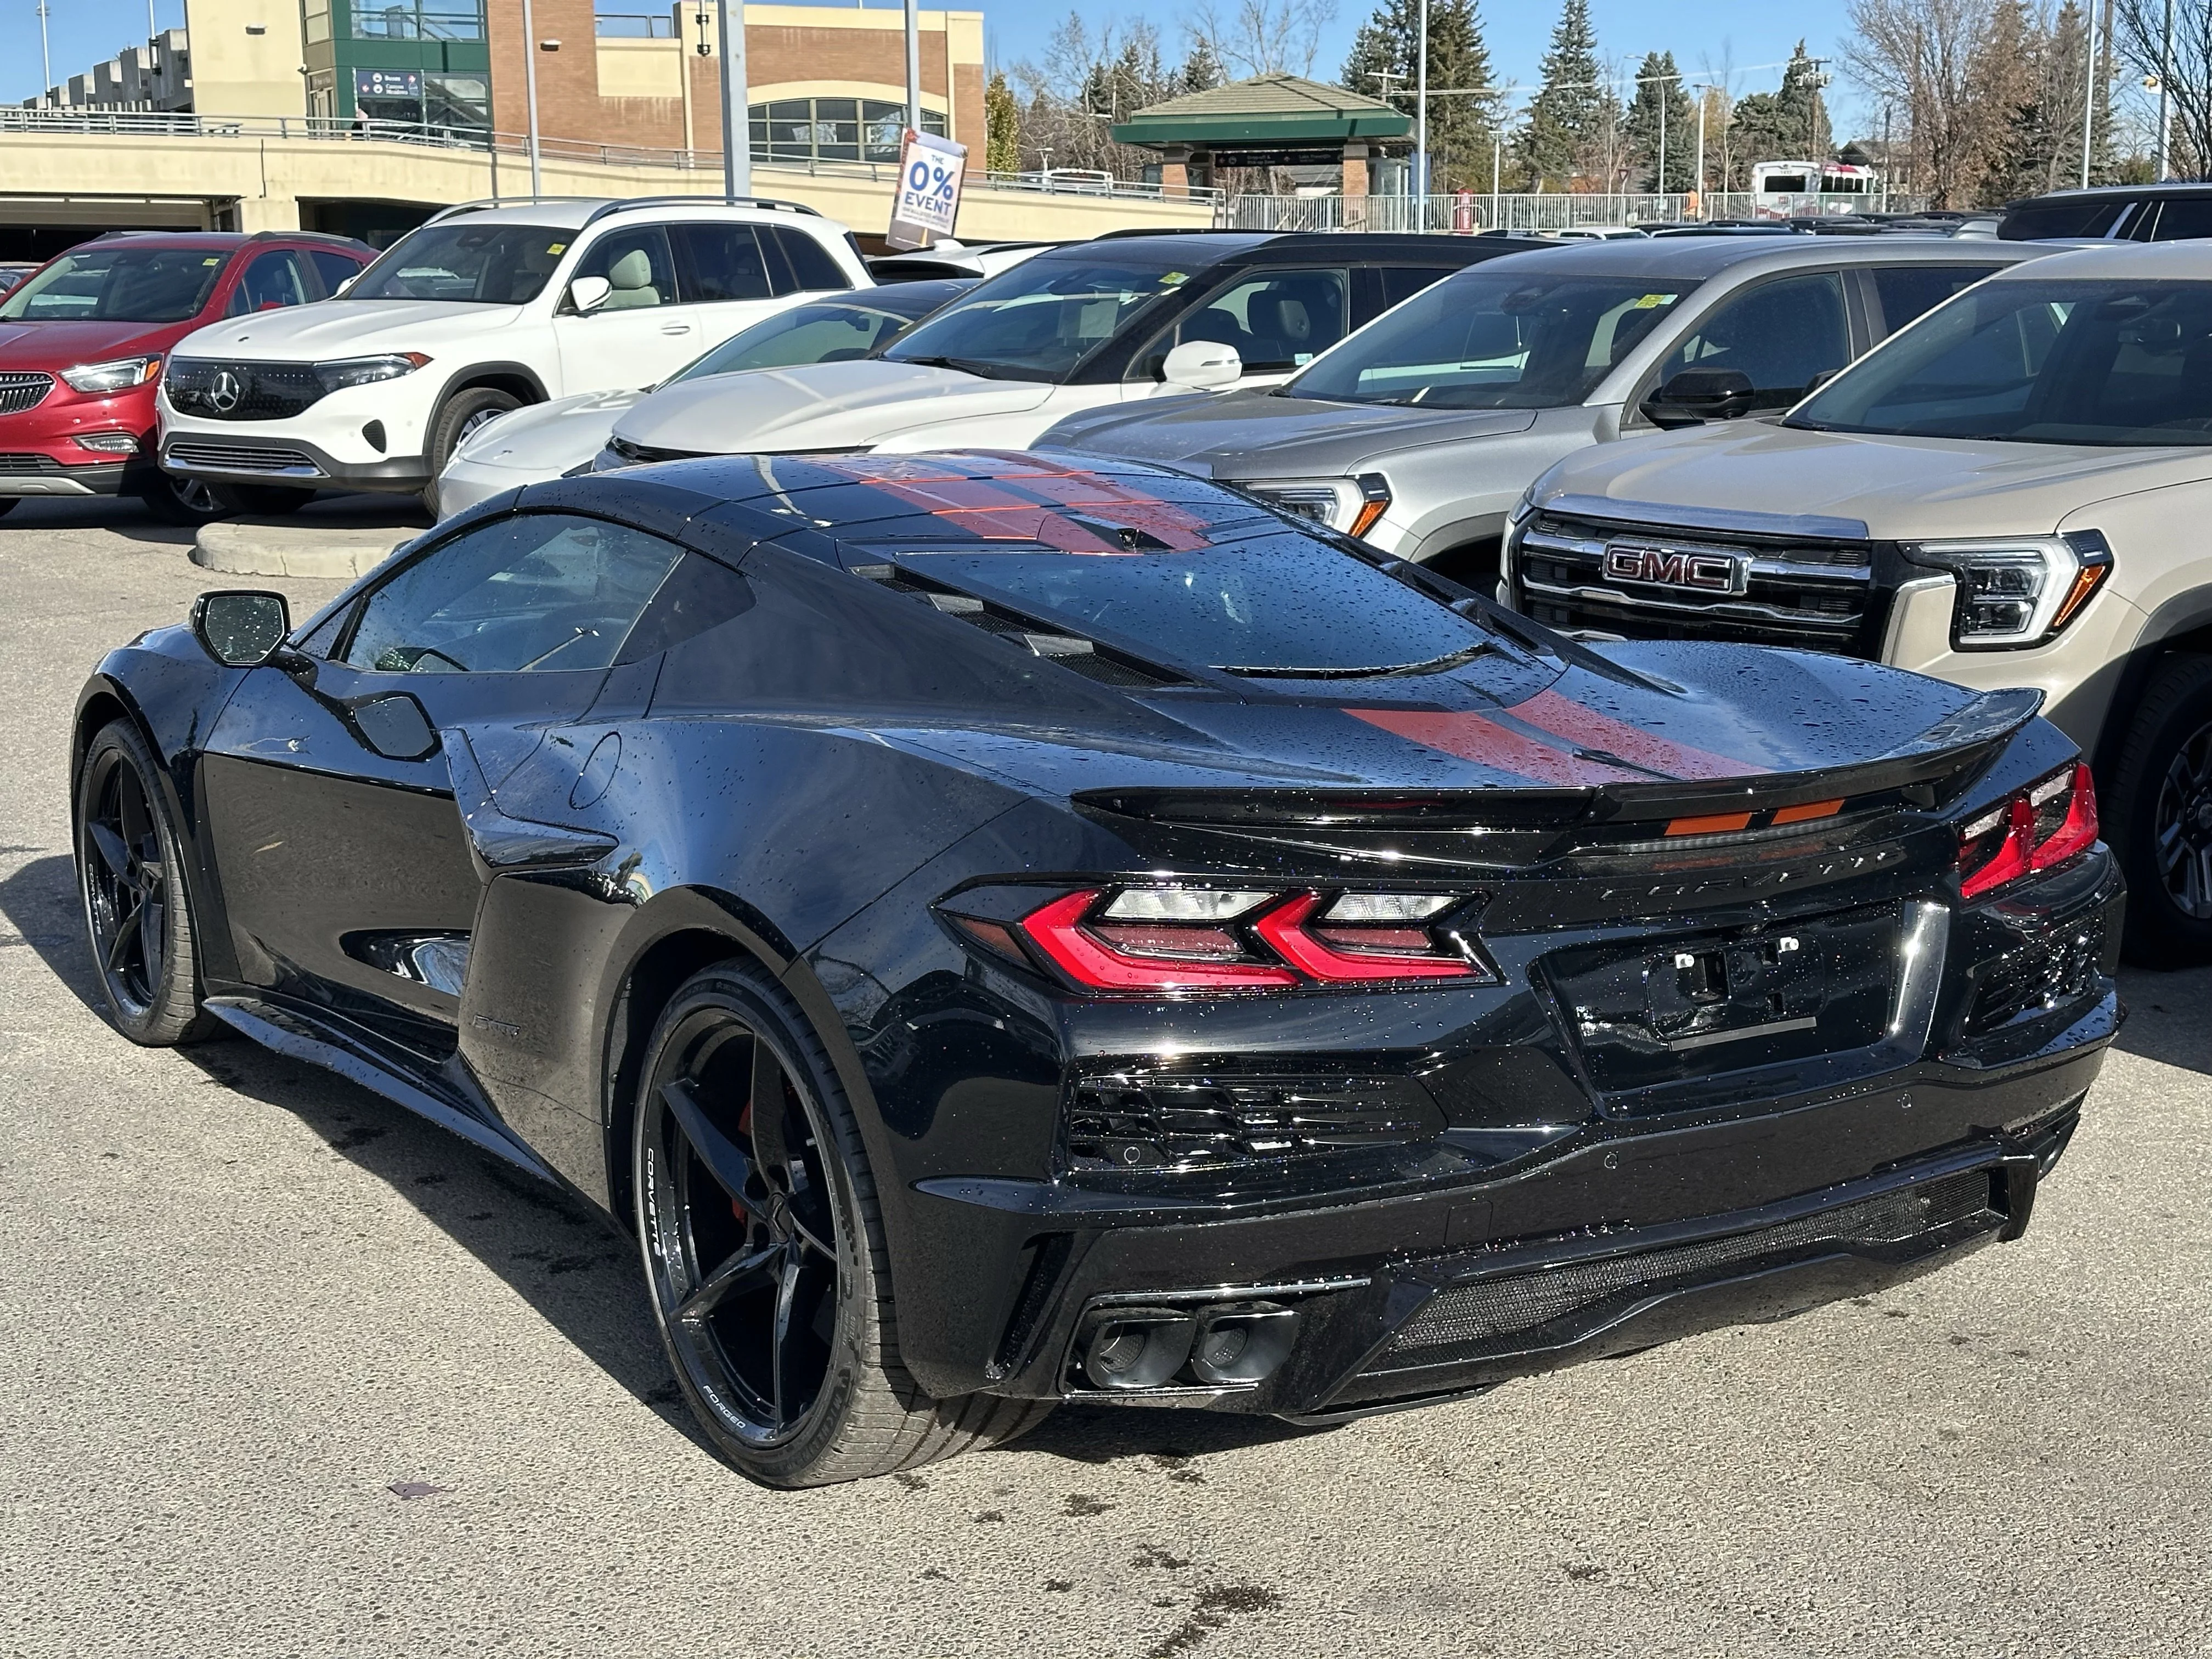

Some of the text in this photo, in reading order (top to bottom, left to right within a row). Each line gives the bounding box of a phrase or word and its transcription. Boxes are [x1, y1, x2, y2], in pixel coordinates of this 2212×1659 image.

[909, 161, 955, 200] 0%
[931, 154, 944, 165] THE
[905, 191, 952, 215] EVENT
[1607, 547, 1731, 589] GMC
[1599, 845, 1906, 901] CORVETTE
[648, 1147, 661, 1257] CORVETTE
[703, 1385, 746, 1429] FORGED
